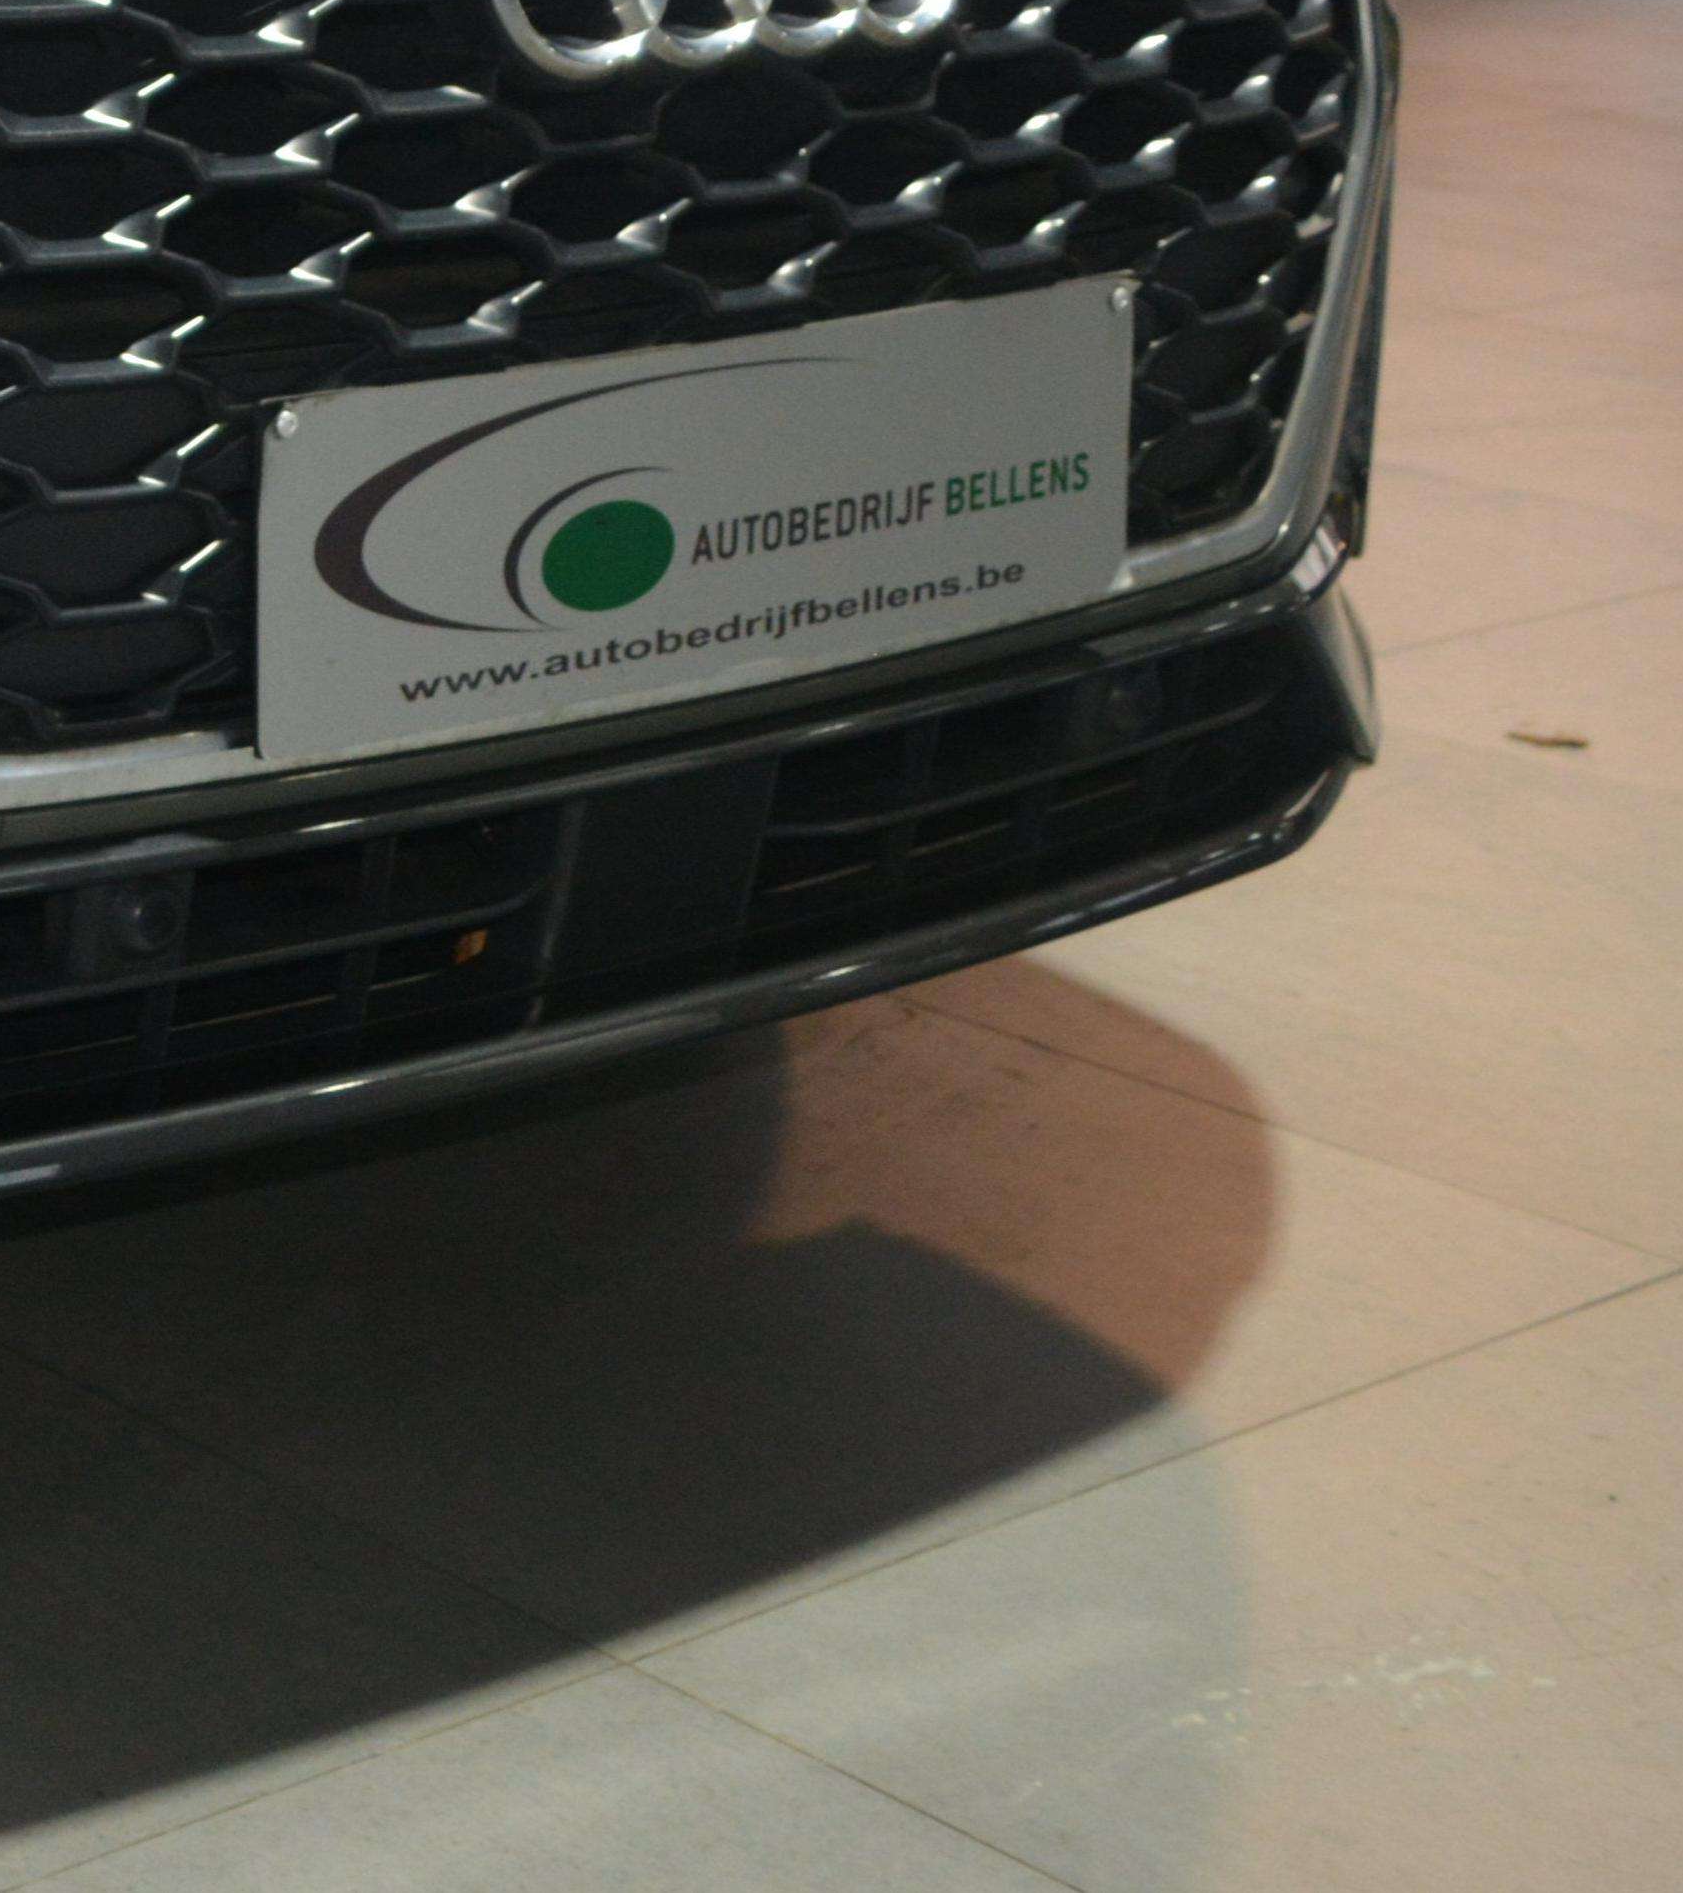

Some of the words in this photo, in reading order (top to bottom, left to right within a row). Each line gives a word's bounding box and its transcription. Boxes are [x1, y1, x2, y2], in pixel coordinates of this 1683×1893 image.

[691, 481, 935, 566] AUTOBEDRIJF
[945, 452, 1091, 518] BELLENS
[399, 561, 1025, 702] www.autobedrijfbellens.be
